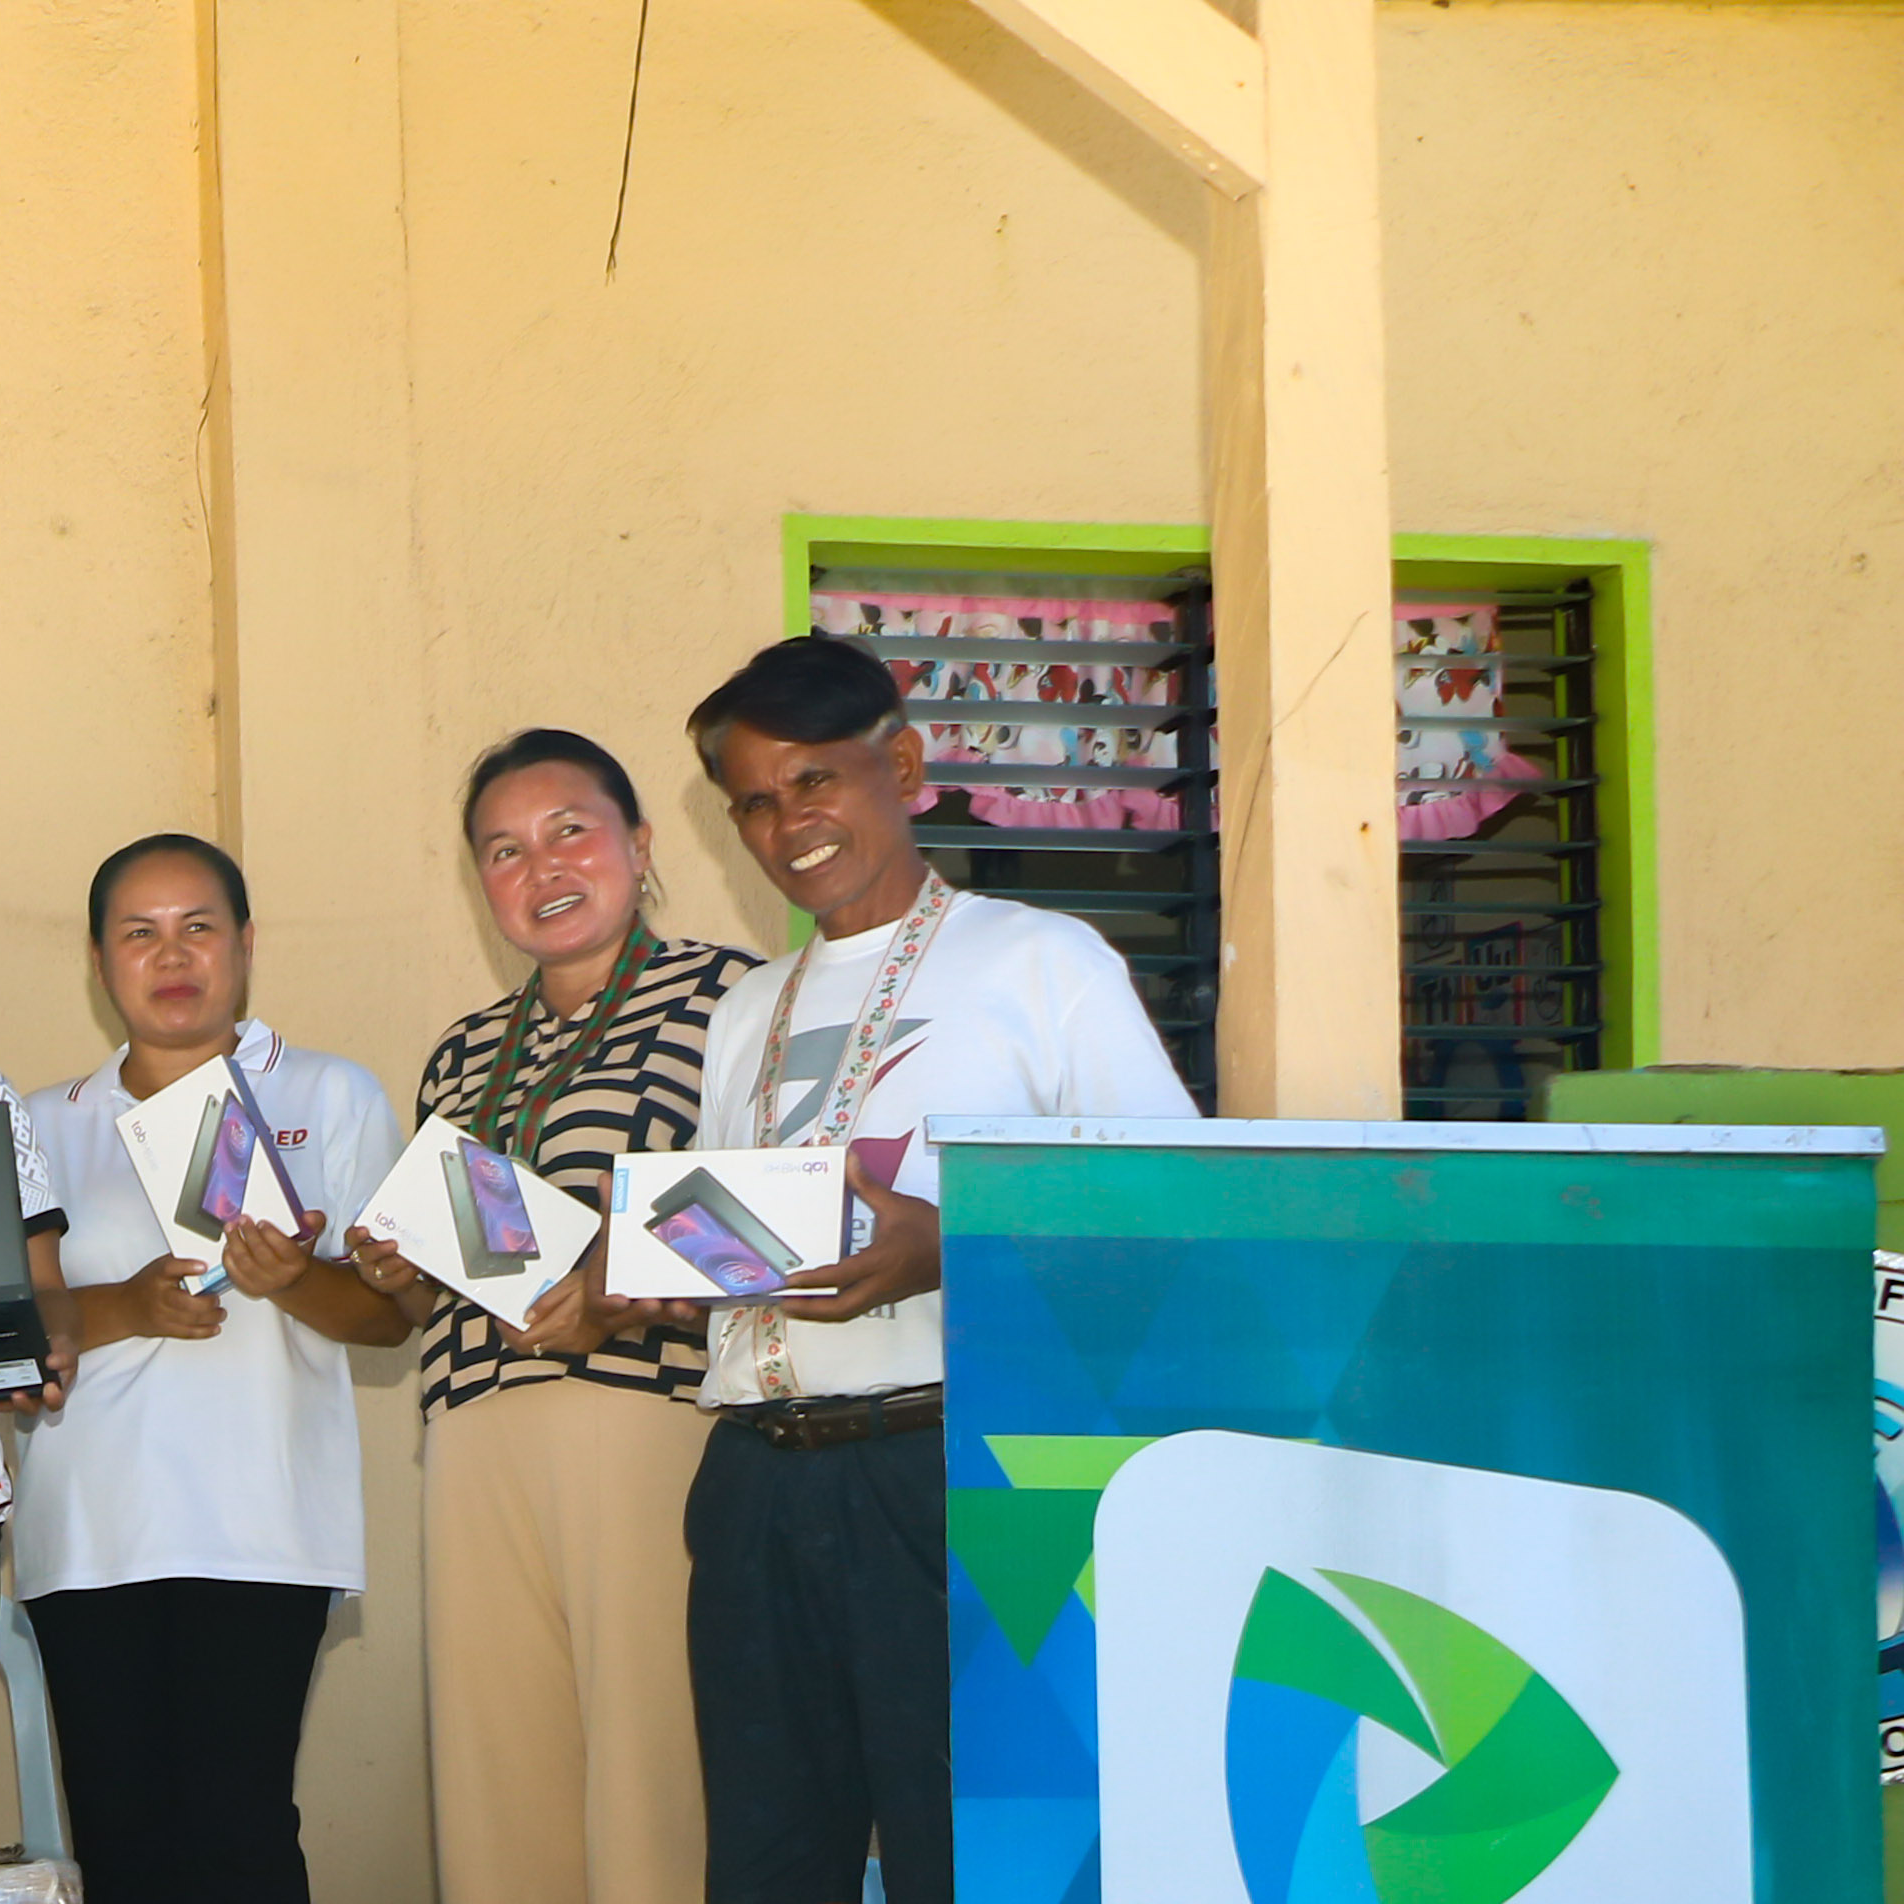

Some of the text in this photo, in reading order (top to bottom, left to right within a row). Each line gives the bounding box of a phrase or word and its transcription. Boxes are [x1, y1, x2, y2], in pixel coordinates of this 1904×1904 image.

[131, 1120, 147, 1144] tab
[802, 1161, 829, 1174] tab
[374, 1212, 397, 1233] tab
